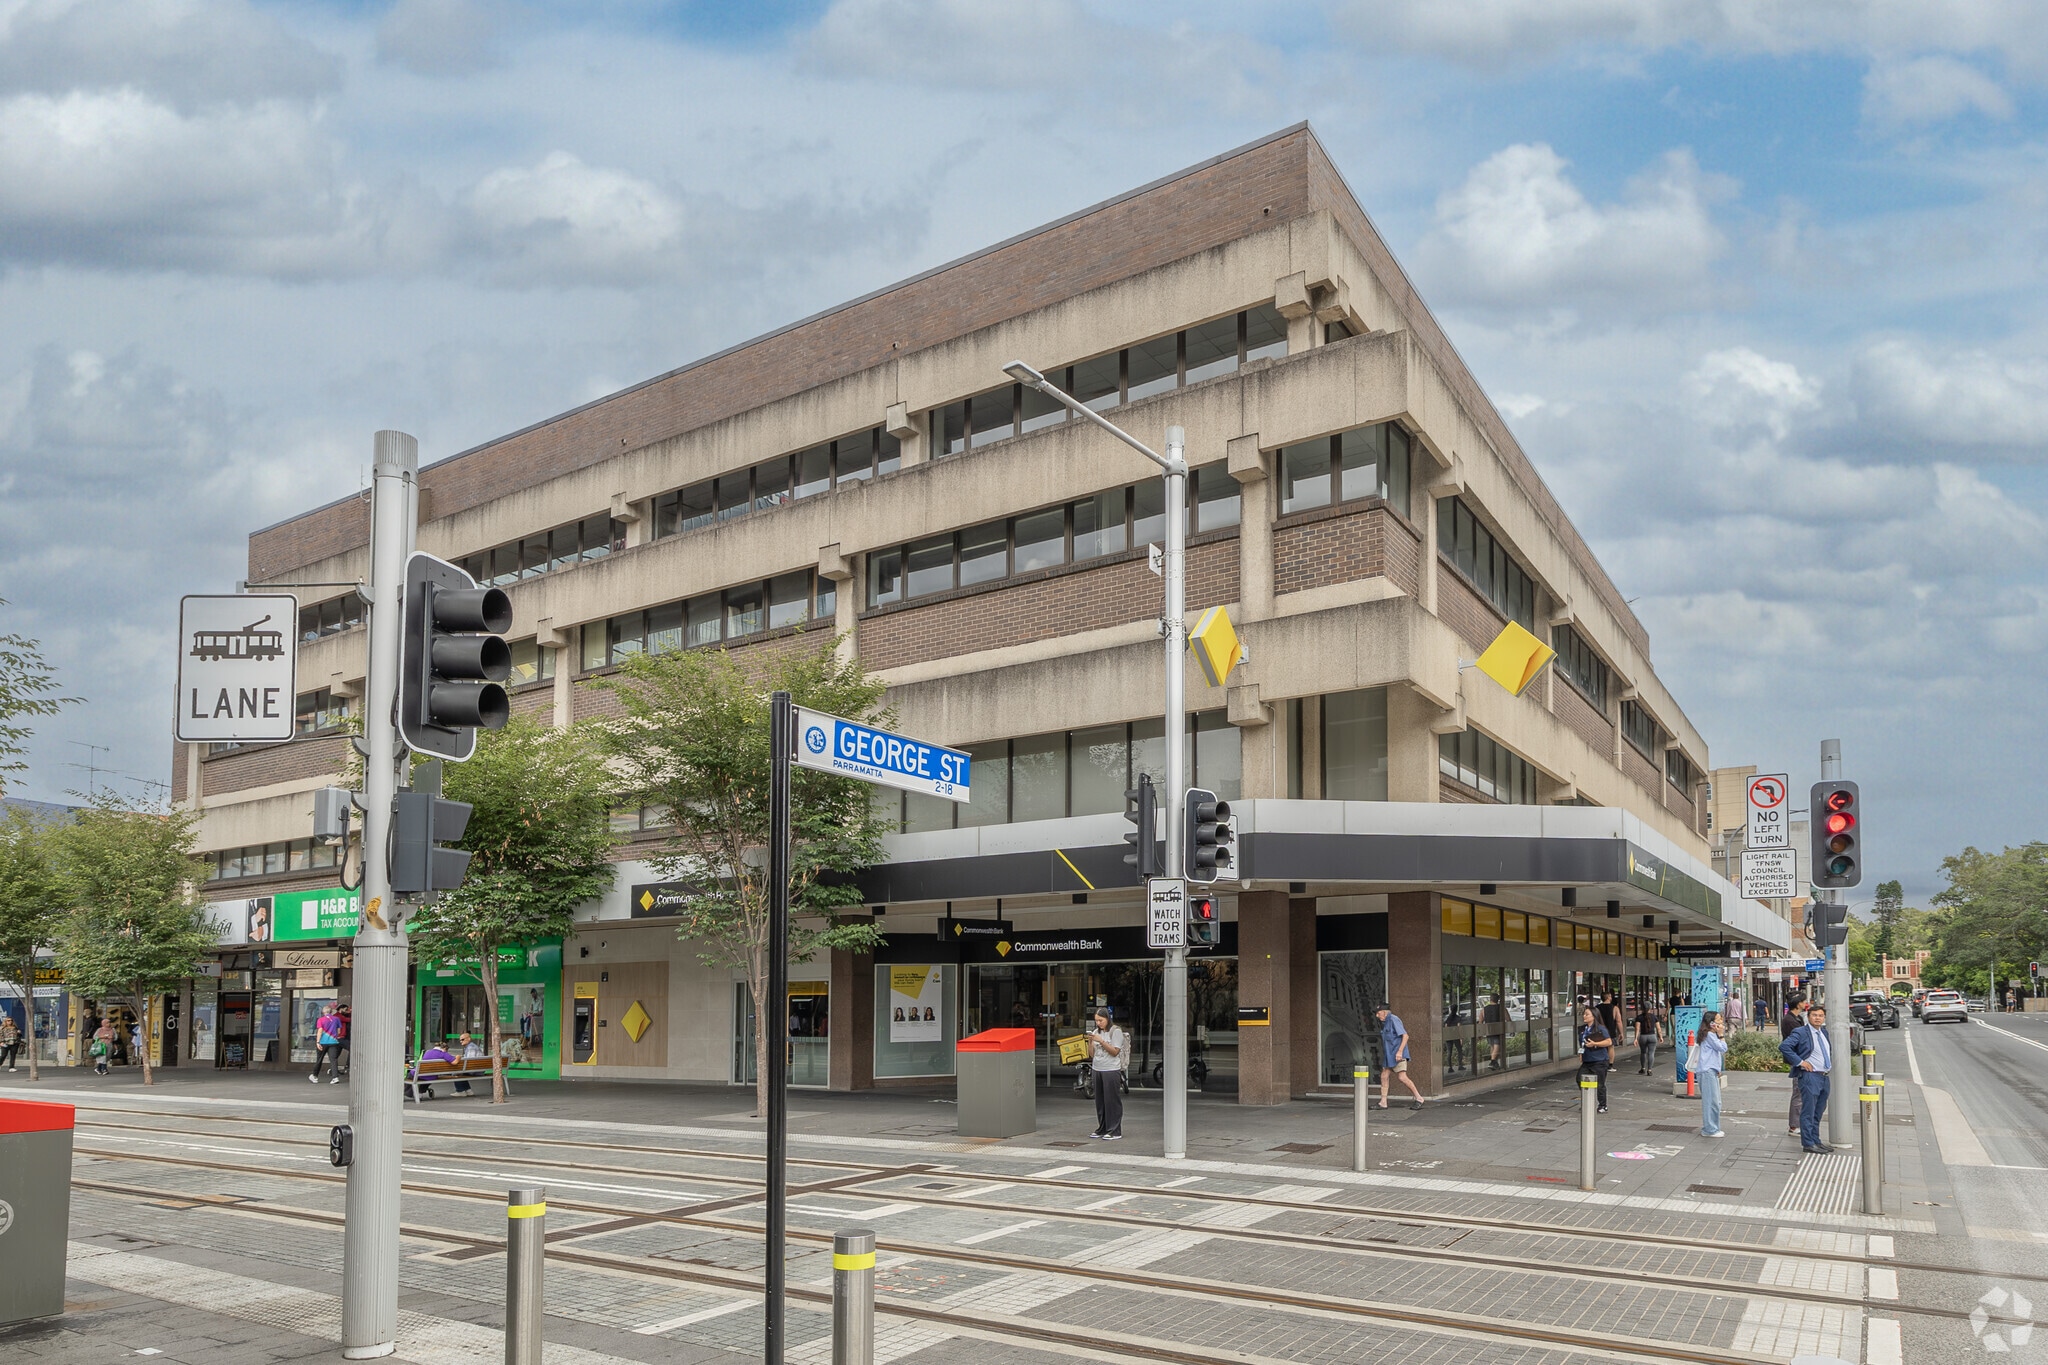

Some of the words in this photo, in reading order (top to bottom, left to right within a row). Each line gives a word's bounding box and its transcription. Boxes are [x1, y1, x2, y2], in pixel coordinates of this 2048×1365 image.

[192, 688, 280, 719] LANE
[840, 726, 930, 777] GEORGE
[939, 753, 965, 784] ST
[832, 759, 883, 778] PARRAMATTA
[935, 781, 953, 796] 2-18
[1757, 811, 1779, 823] NO
[1754, 824, 1780, 834] LEFT
[1754, 835, 1783, 844] TURN
[1748, 888, 1789, 896] EXCEPTED
[320, 898, 347, 915] H&R
[349, 896, 360, 913] B
[1154, 909, 1180, 919] WATCH
[320, 919, 332, 929] TAX
[1154, 922, 1180, 931] FOR
[1154, 934, 1180, 944] TRAMS
[1014, 940, 1080, 952] Commonwealth
[1080, 939, 1102, 950] Bank
[285, 951, 329, 967] Lichaa
